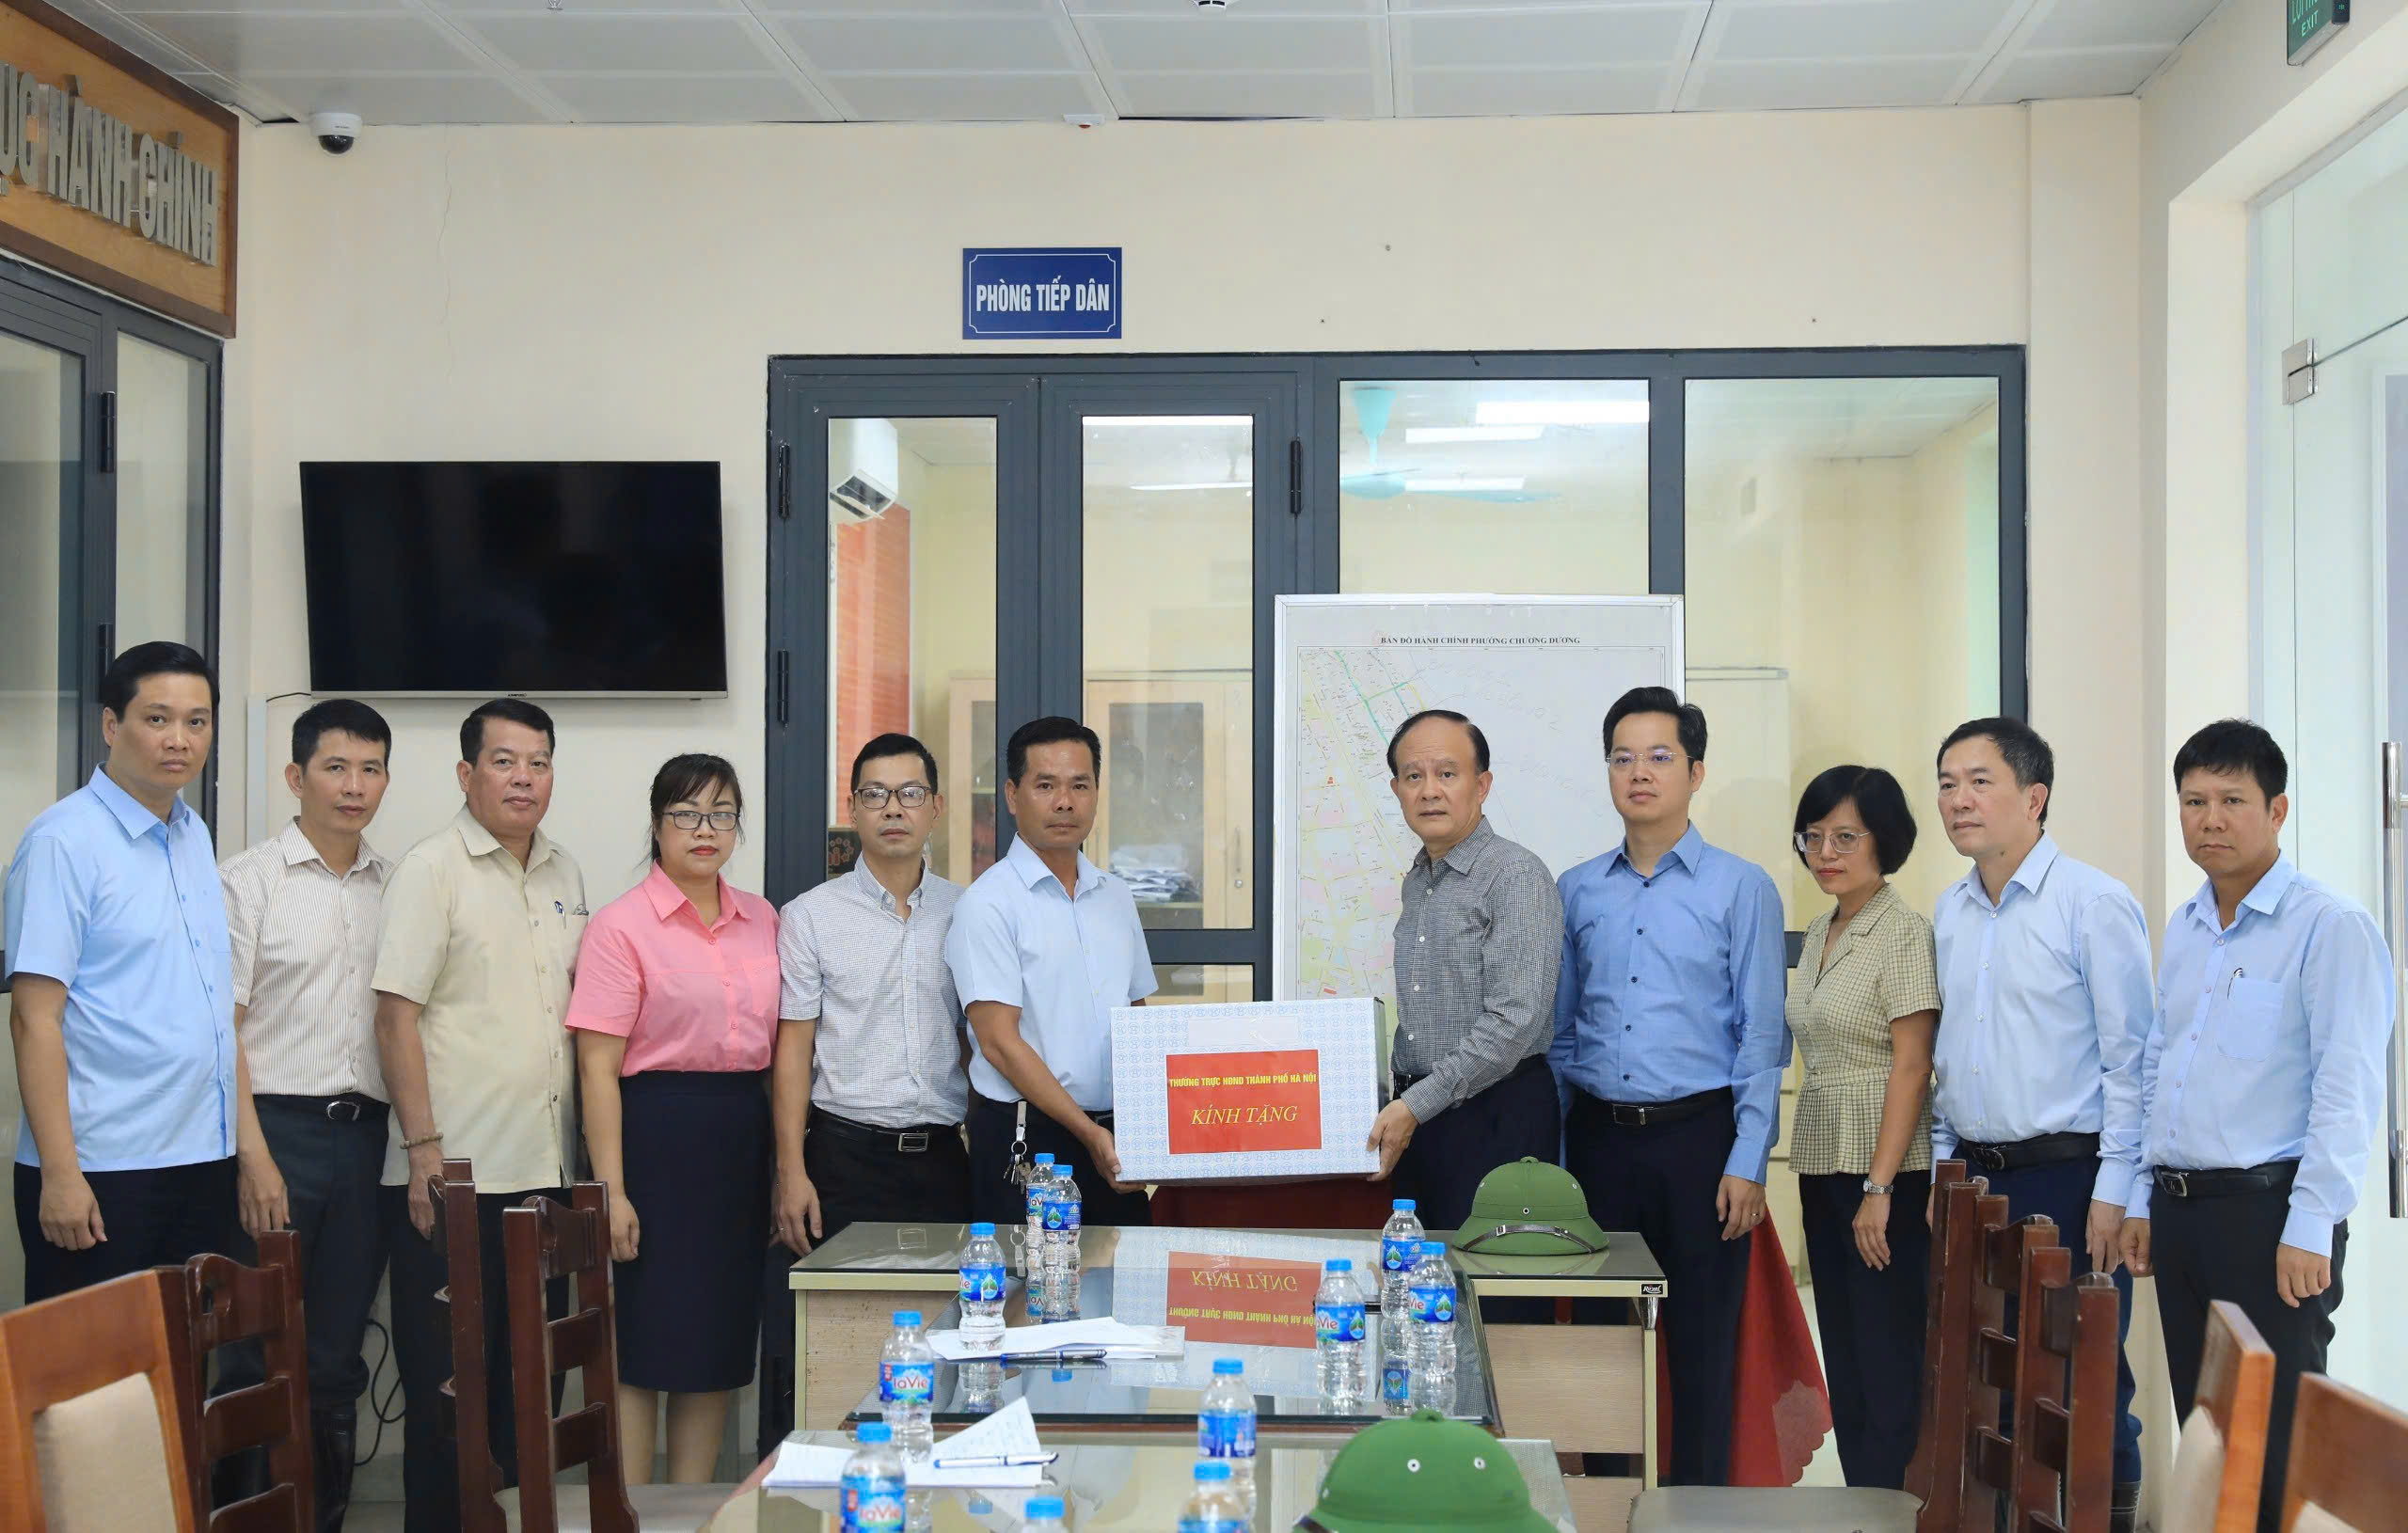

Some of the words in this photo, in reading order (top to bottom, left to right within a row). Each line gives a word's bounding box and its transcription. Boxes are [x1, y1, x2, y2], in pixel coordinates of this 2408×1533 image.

[2301, 10, 2319, 37] EXIT
[47, 75, 133, 227] HÀNH
[139, 132, 218, 267] CHÍNH
[976, 278, 1031, 312] PHÒNG
[1036, 276, 1070, 311] TIẾP
[1076, 278, 1109, 311] DÂN
[1441, 636, 1468, 644] CHÍNH
[1201, 1076, 1221, 1088] TRỰC
[1273, 1072, 1289, 1083] PHỐ
[1291, 1073, 1301, 1083] HÀ
[1303, 1072, 1317, 1083] NỘI
[1191, 1104, 1241, 1125] KÍNH
[1246, 1104, 1297, 1126] TẶNG
[1030, 1197, 1043, 1207] laV
[1317, 1317, 1339, 1329] Vie
[894, 1376, 927, 1388] laVie
